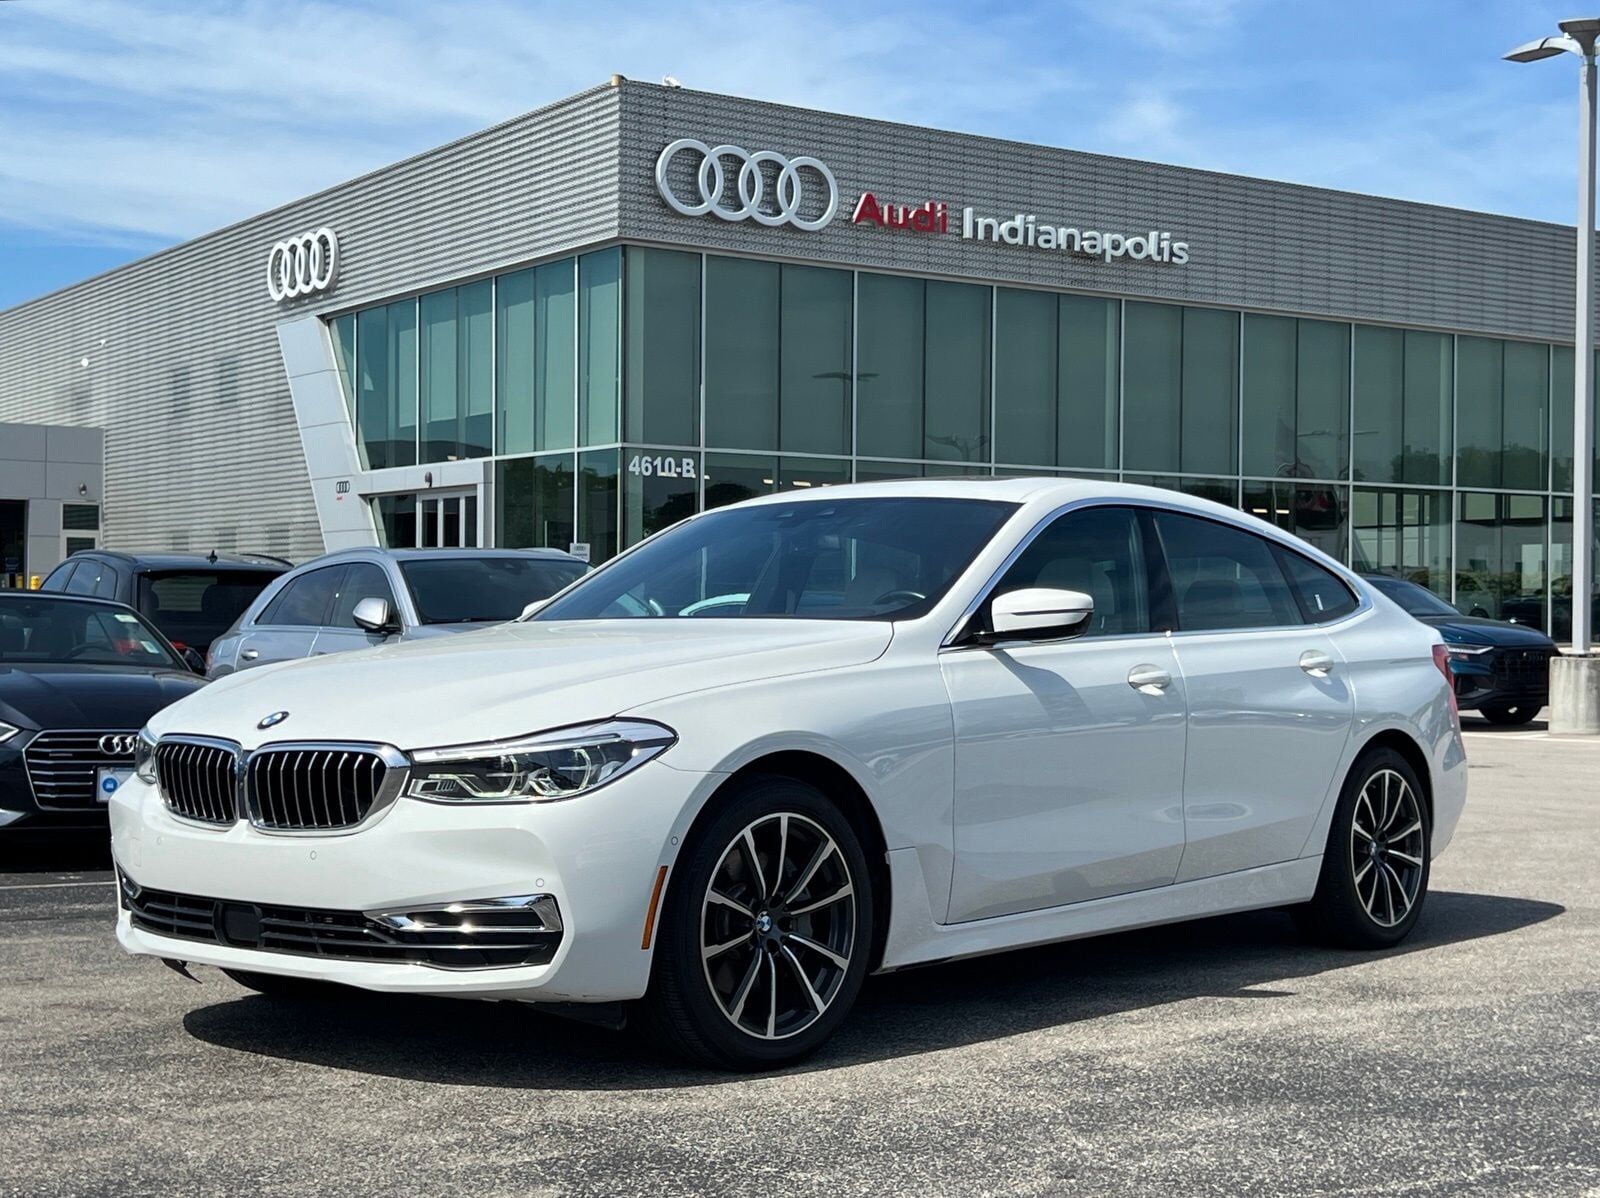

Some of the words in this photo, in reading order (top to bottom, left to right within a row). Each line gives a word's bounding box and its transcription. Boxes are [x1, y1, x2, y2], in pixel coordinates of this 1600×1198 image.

[852, 191, 948, 234] Audi
[962, 207, 1189, 264] Indianapolis
[628, 455, 696, 478] 4610-B
